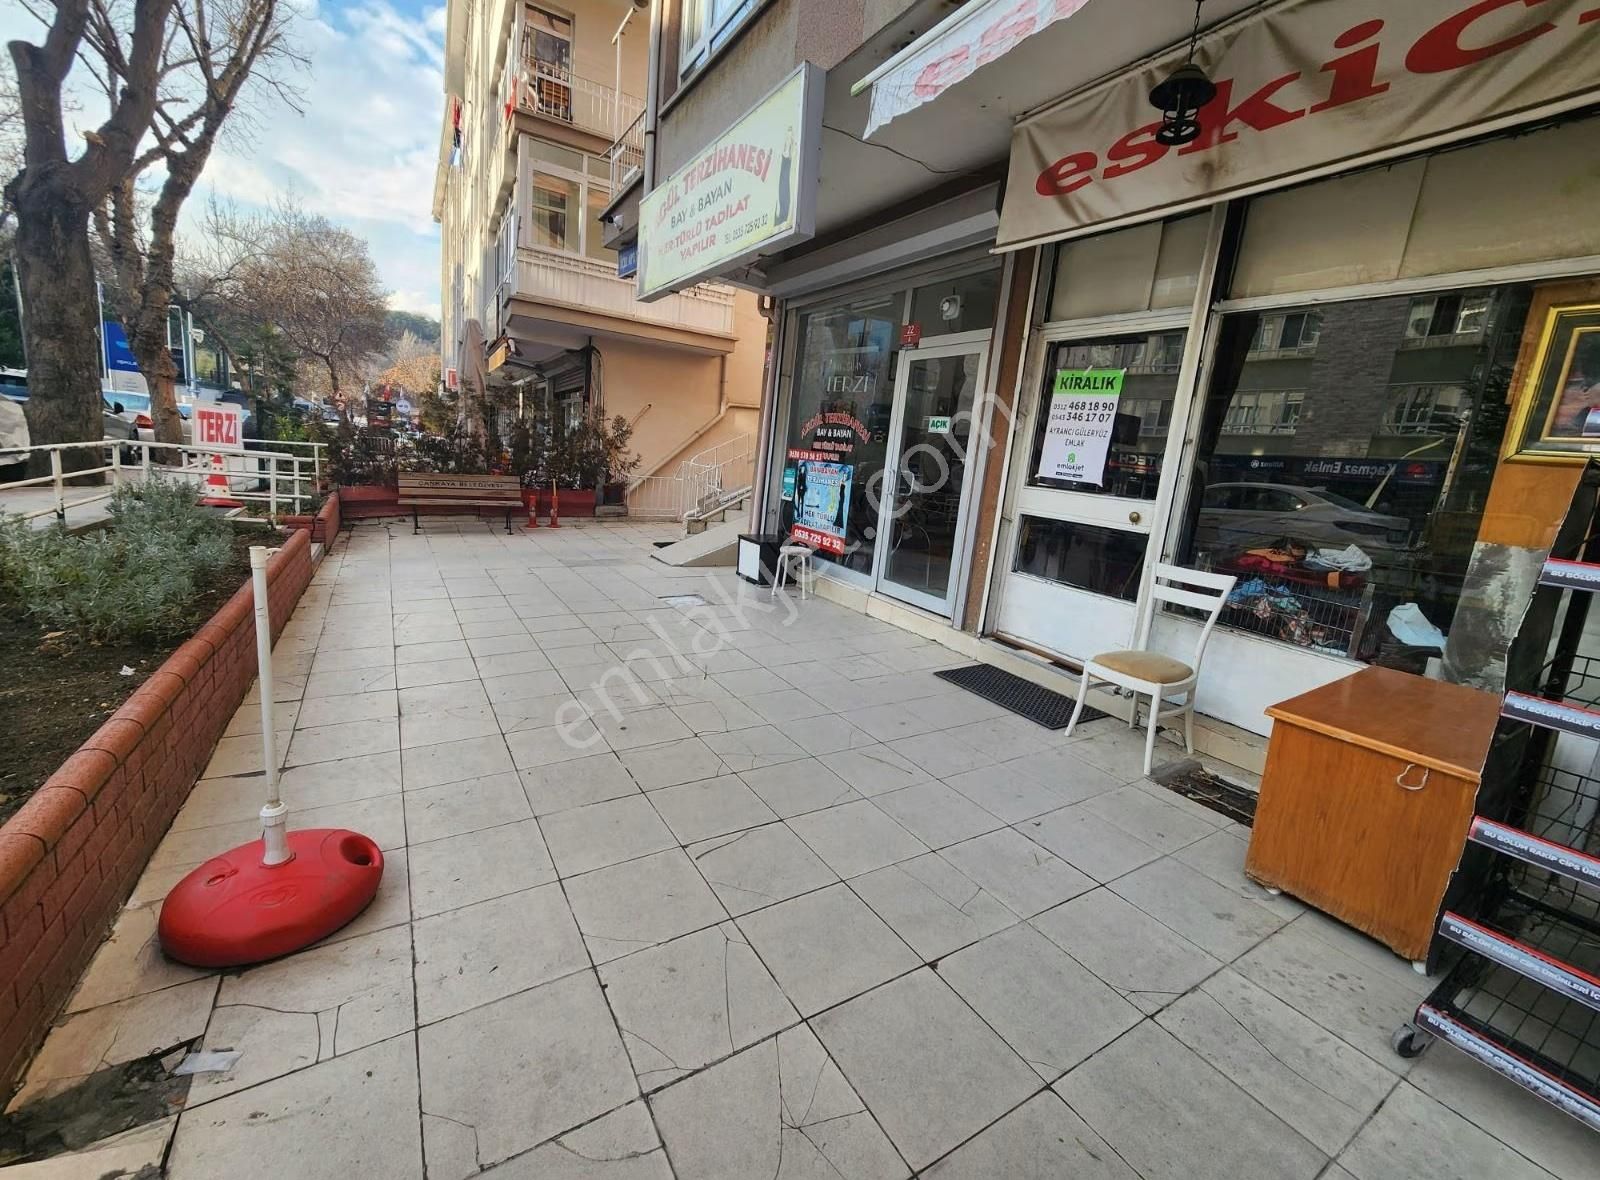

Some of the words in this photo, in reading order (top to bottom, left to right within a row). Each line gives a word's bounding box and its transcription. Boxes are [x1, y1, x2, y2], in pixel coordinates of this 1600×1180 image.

[1036, 0, 1600, 197] eskic
[671, 208, 687, 228] BAY
[698, 177, 732, 212] BAYAN
[705, 194, 751, 231] TADİLAT
[680, 234, 716, 261] YAPILIR
[1059, 374, 1117, 390] KİRALIK
[1068, 401, 1086, 411] 468
[1088, 402, 1099, 411] 18
[1102, 402, 1114, 412] 90
[1066, 412, 1083, 421] 346
[1085, 413, 1096, 422] 17
[1099, 413, 1111, 423] 07
[930, 418, 948, 430] AÇIK
[817, 428, 827, 437] BAY
[832, 429, 852, 438] BAYAN
[1075, 427, 1108, 438] GÜLERYÜZ
[1064, 439, 1085, 447] EMLAK
[1057, 463, 1084, 472] emlakjet
[794, 529, 808, 538] 0535
[810, 533, 821, 543] 725
[823, 537, 831, 547] 92
[832, 541, 841, 550] 32
